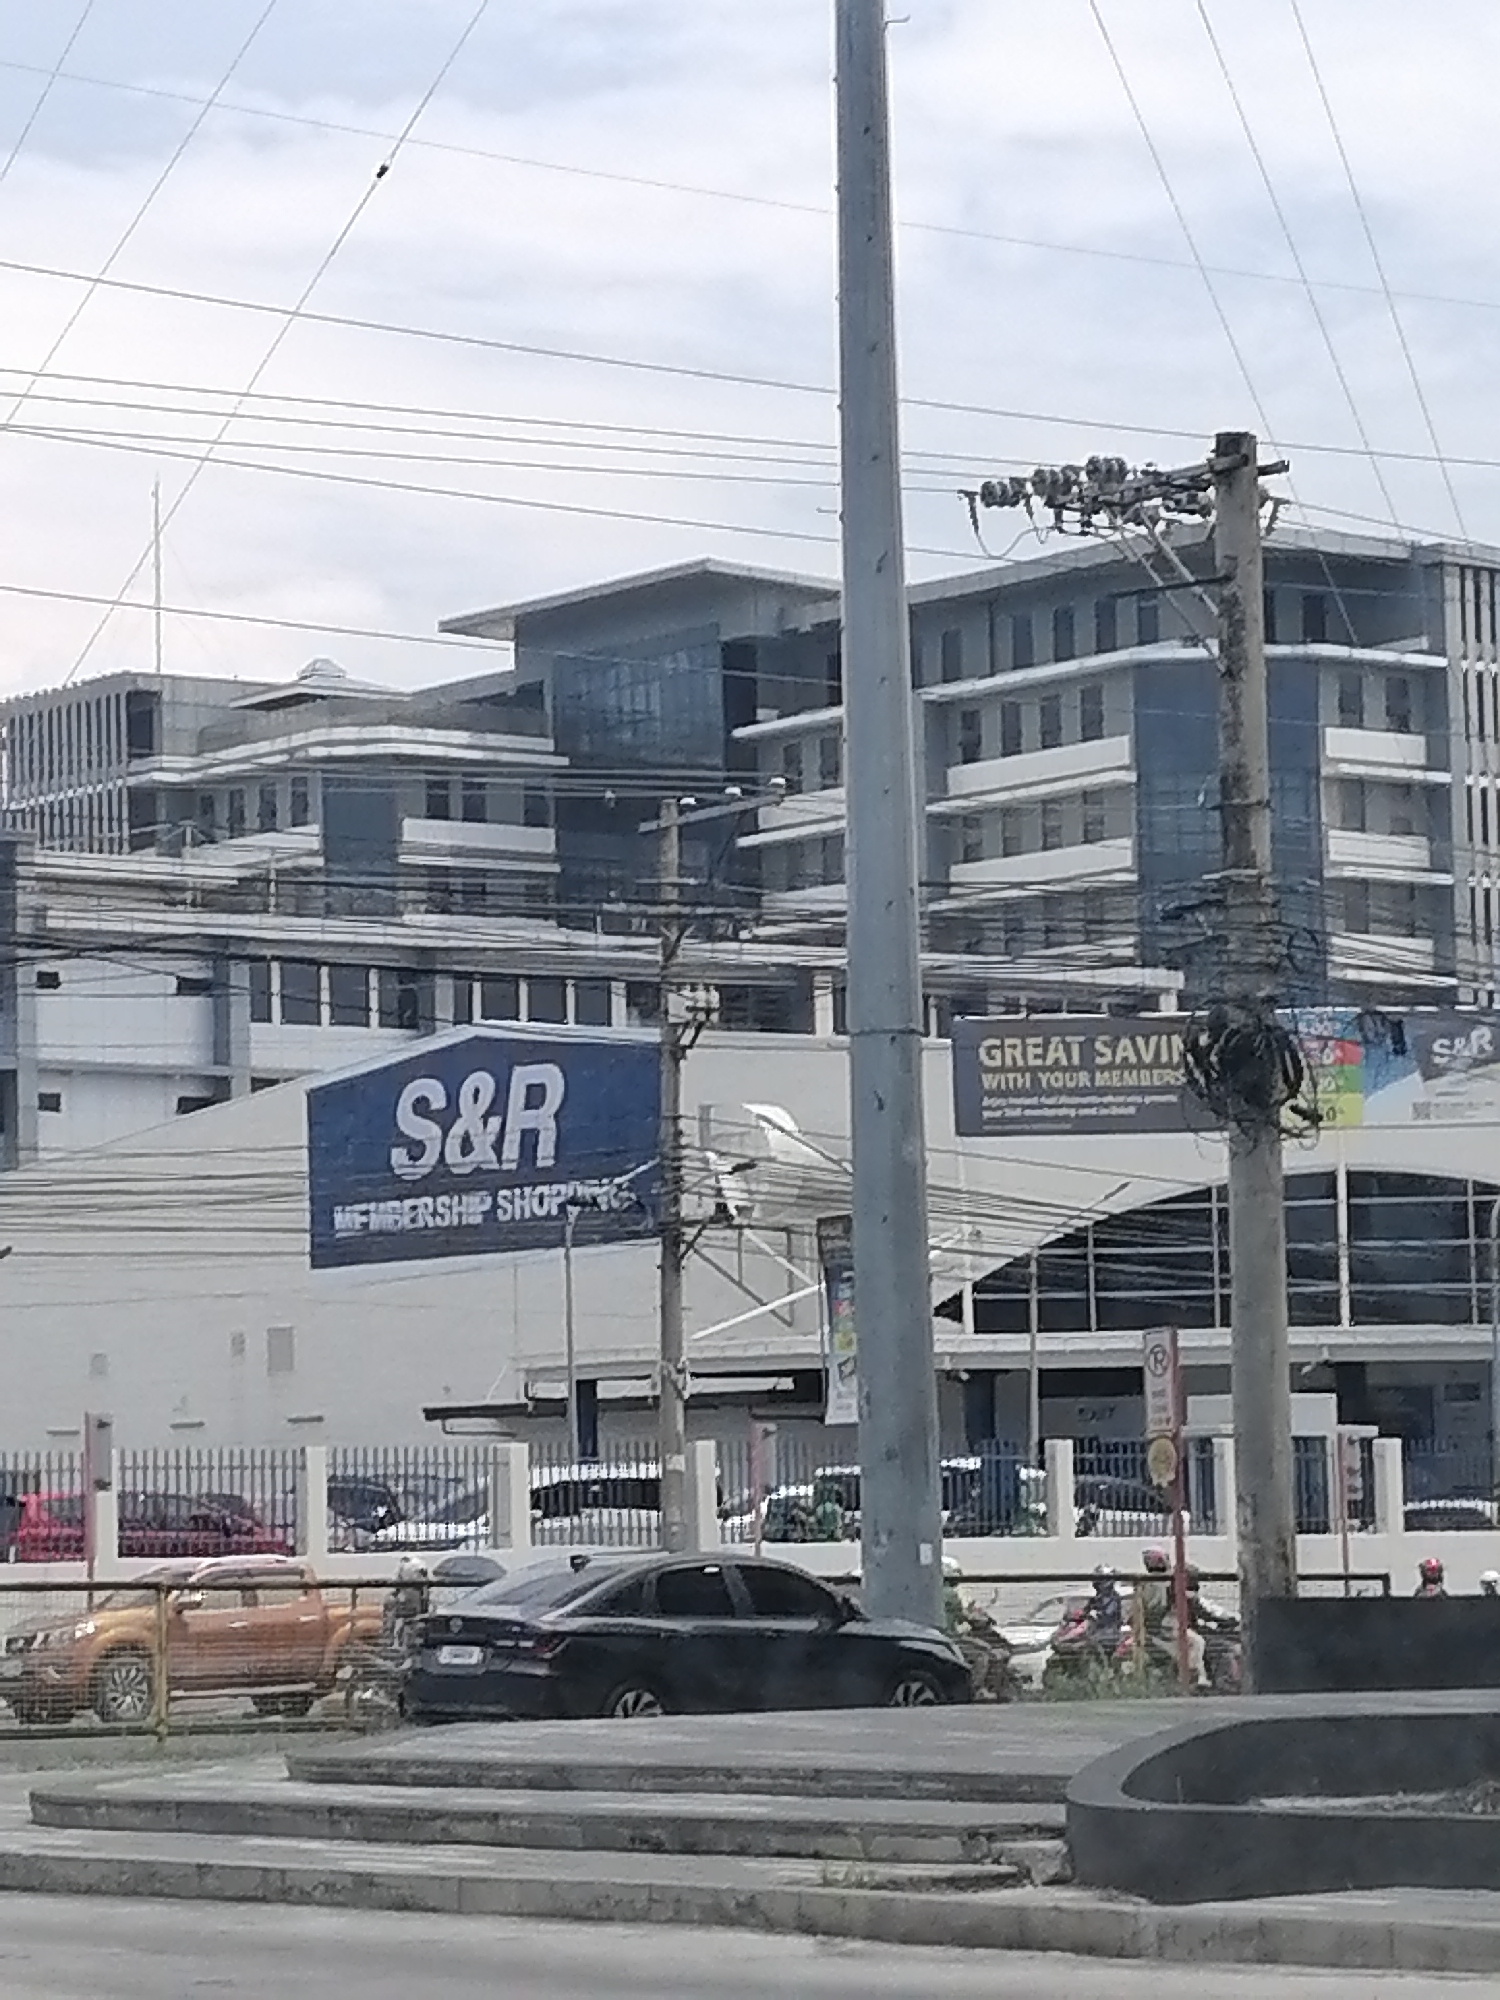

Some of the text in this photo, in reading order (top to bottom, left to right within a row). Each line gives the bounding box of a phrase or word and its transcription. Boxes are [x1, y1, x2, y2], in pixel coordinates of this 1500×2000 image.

[979, 1034, 1185, 1068] GREAT SAVIN
[981, 1068, 1188, 1091] WITH YOUR MEMBERS
[391, 1062, 565, 1180] S&R
